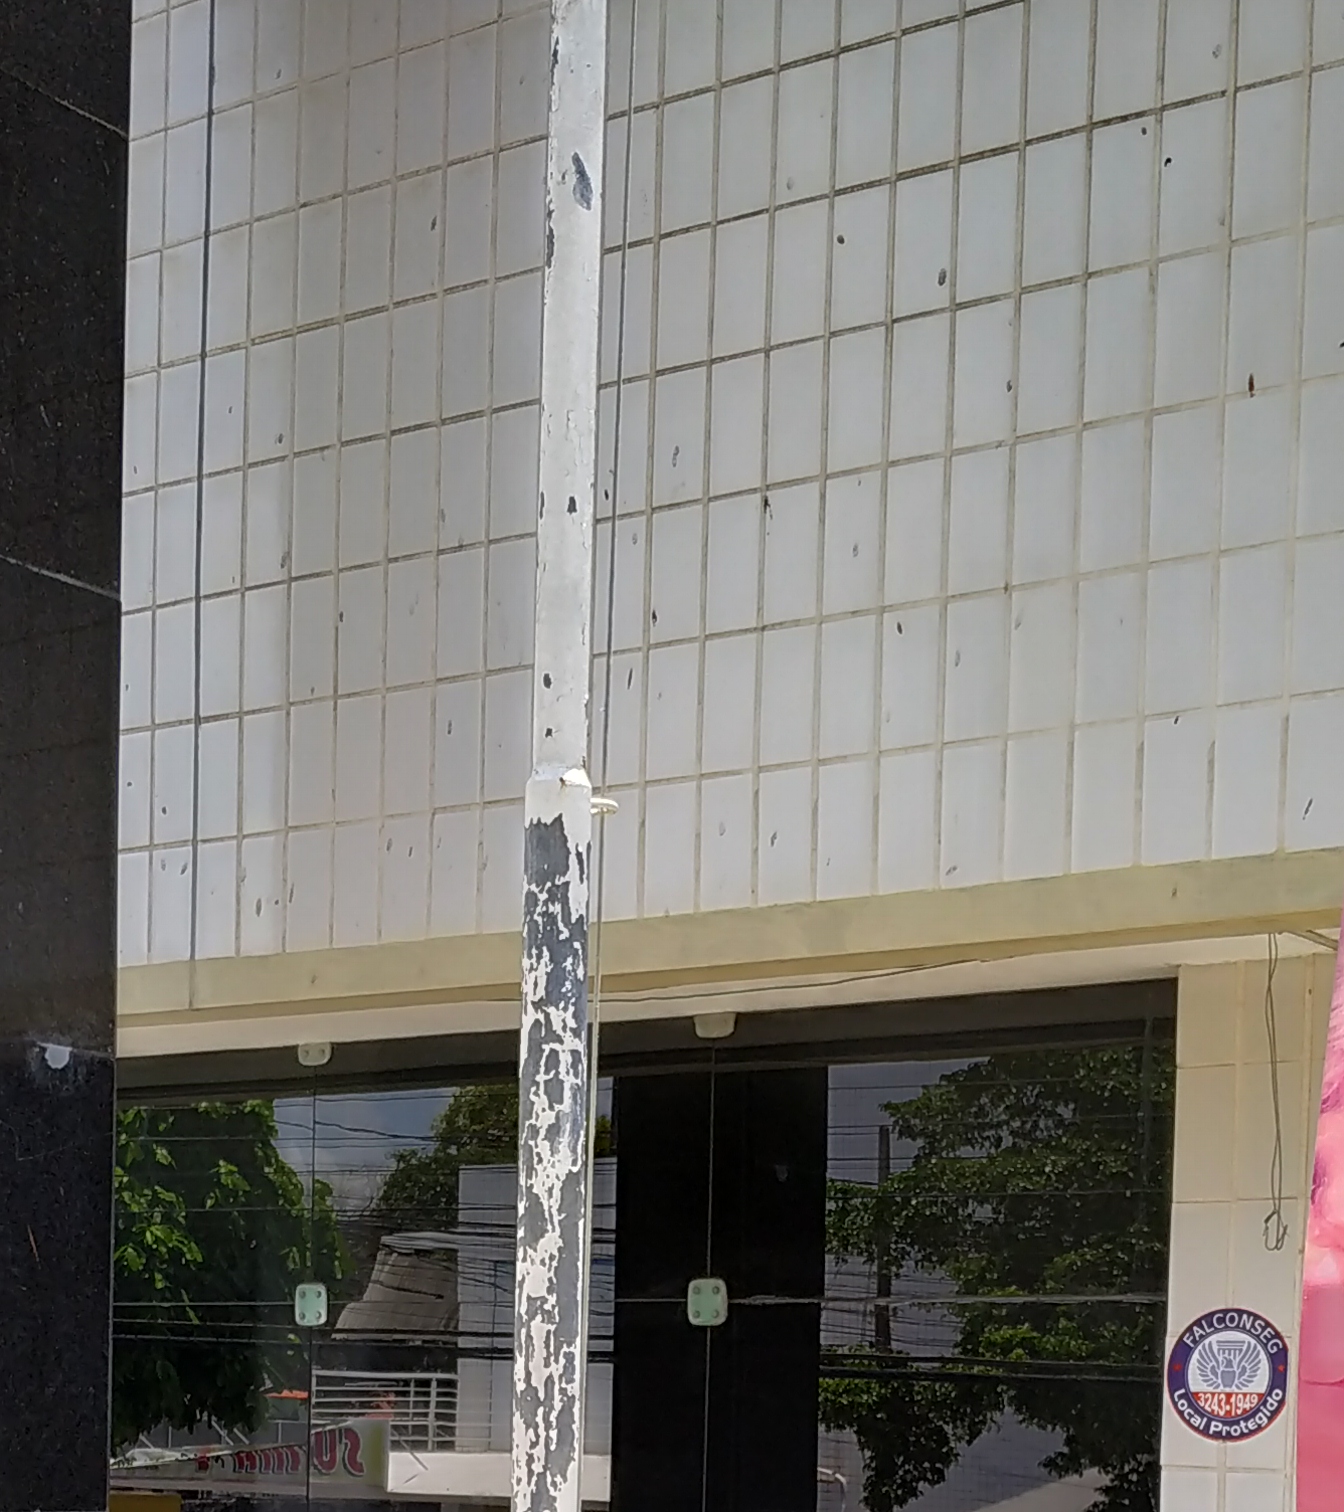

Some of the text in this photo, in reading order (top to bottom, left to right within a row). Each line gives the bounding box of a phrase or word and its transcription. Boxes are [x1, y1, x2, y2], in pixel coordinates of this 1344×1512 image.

[1182, 1312, 1283, 1354] FALCONSEG
[1173, 1387, 1283, 1437] Local Protegido
[1197, 1392, 1259, 1416] 3243-1949
